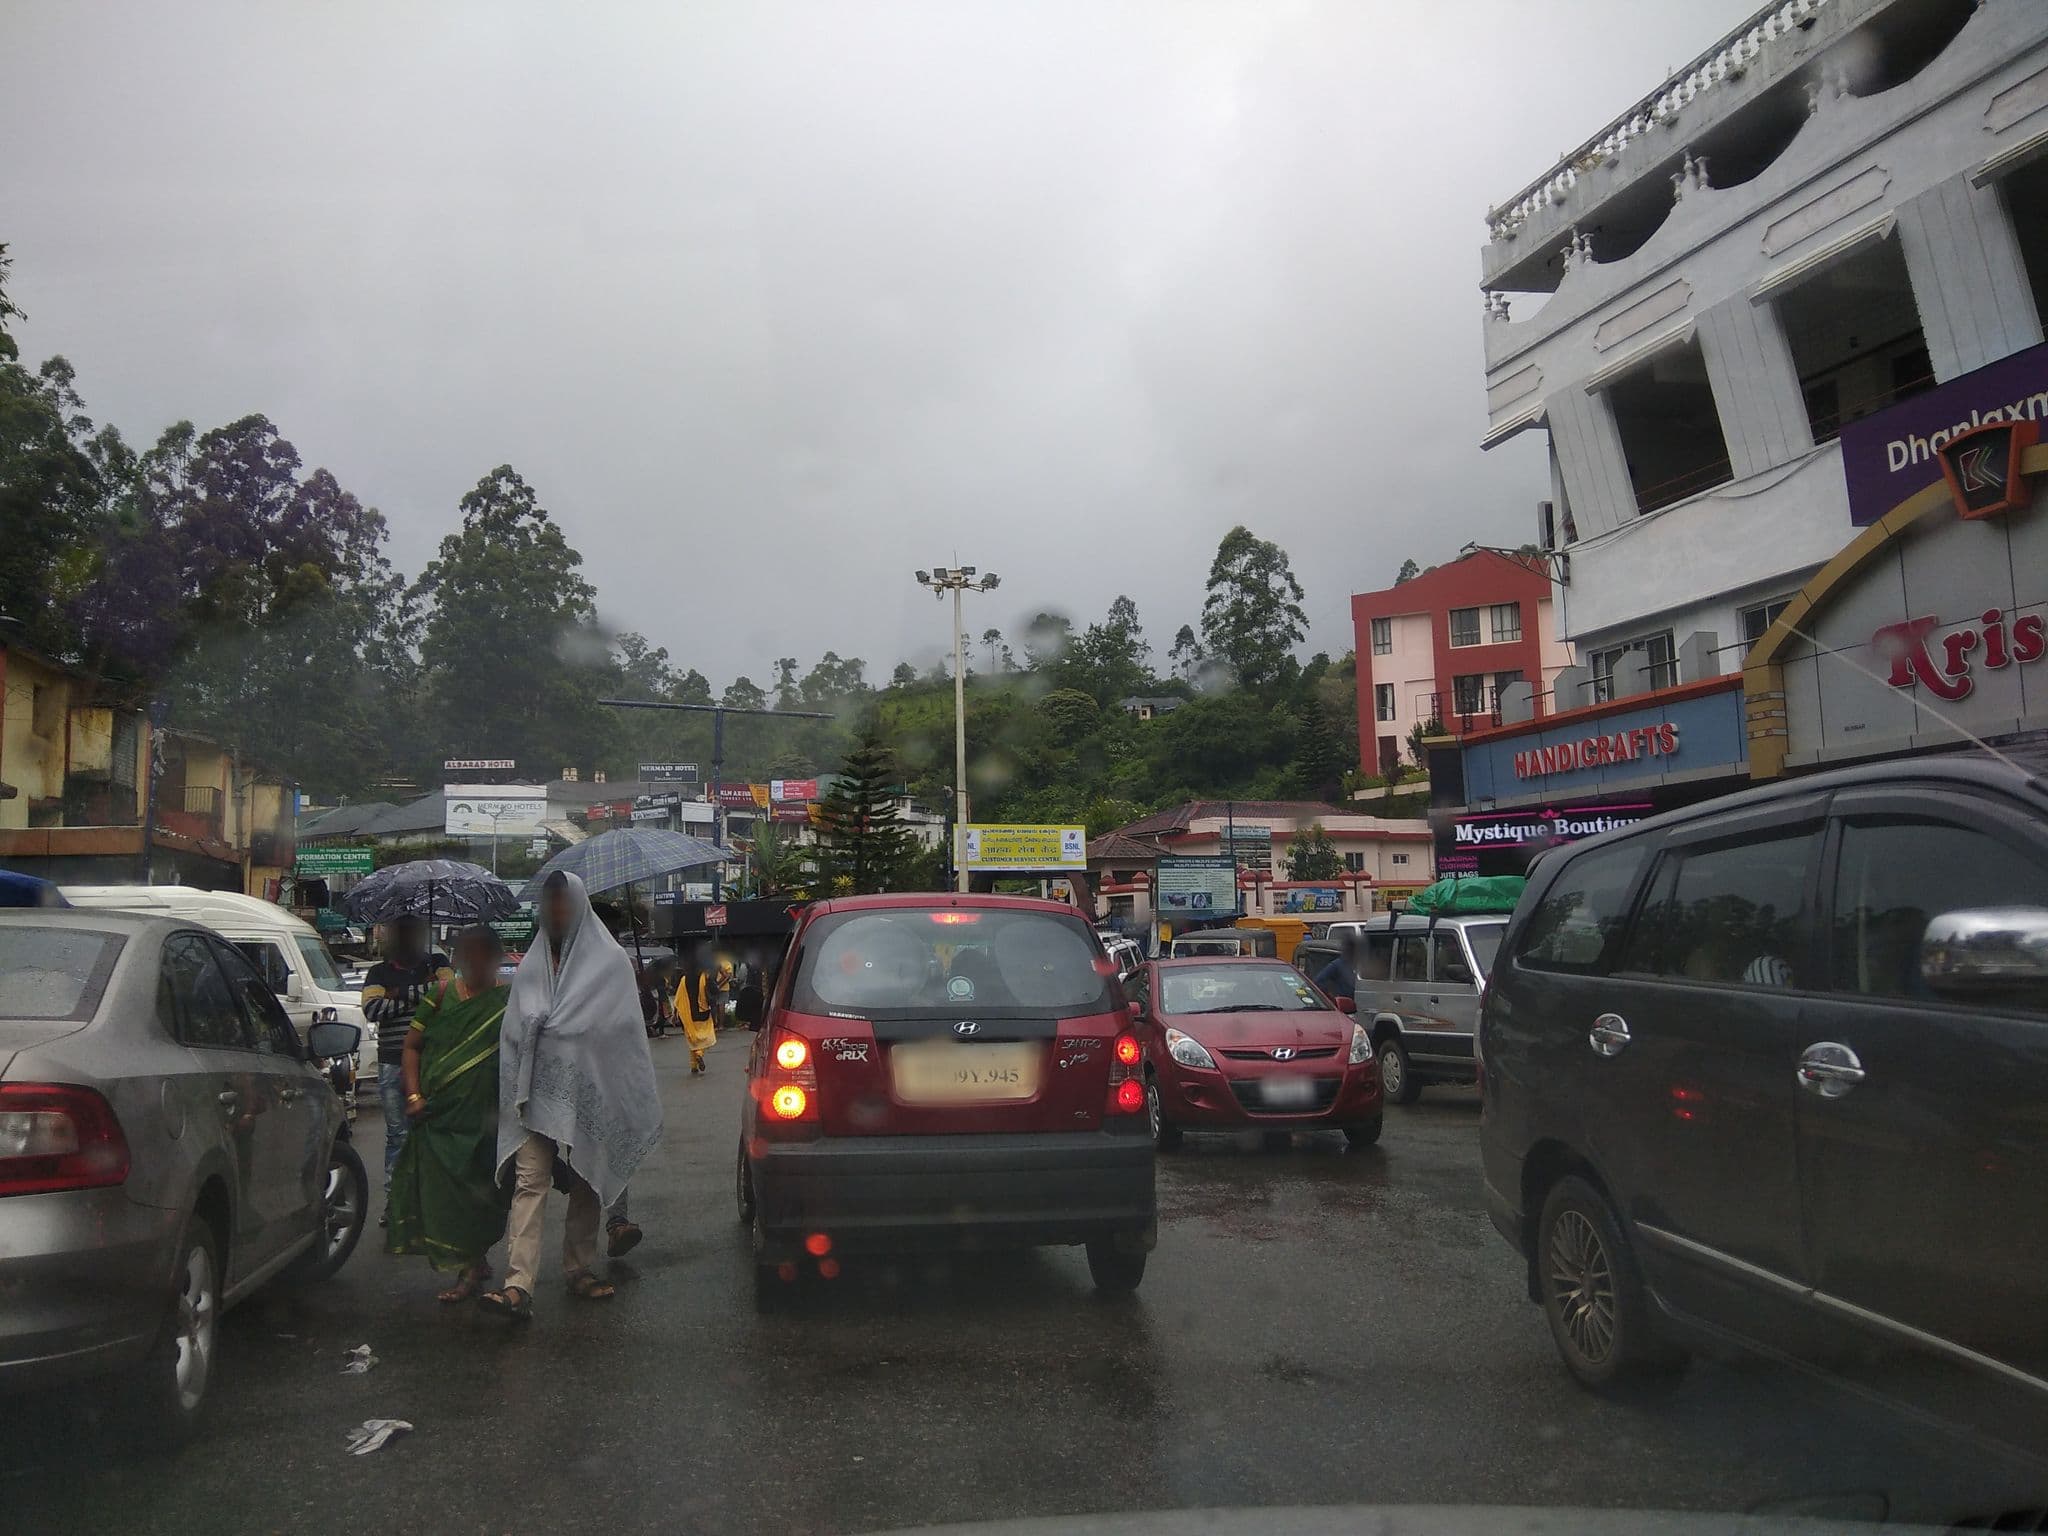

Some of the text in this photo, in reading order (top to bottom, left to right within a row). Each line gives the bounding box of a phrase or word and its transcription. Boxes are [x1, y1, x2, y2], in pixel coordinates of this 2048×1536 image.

[1872, 608, 2046, 701] Kris
[1515, 723, 1680, 778] HANDICRAFTS
[1455, 816, 1641, 844] Mystique Bouti
[1064, 842, 1080, 850] BSNL
[1458, 871, 1479, 879] BAGS
